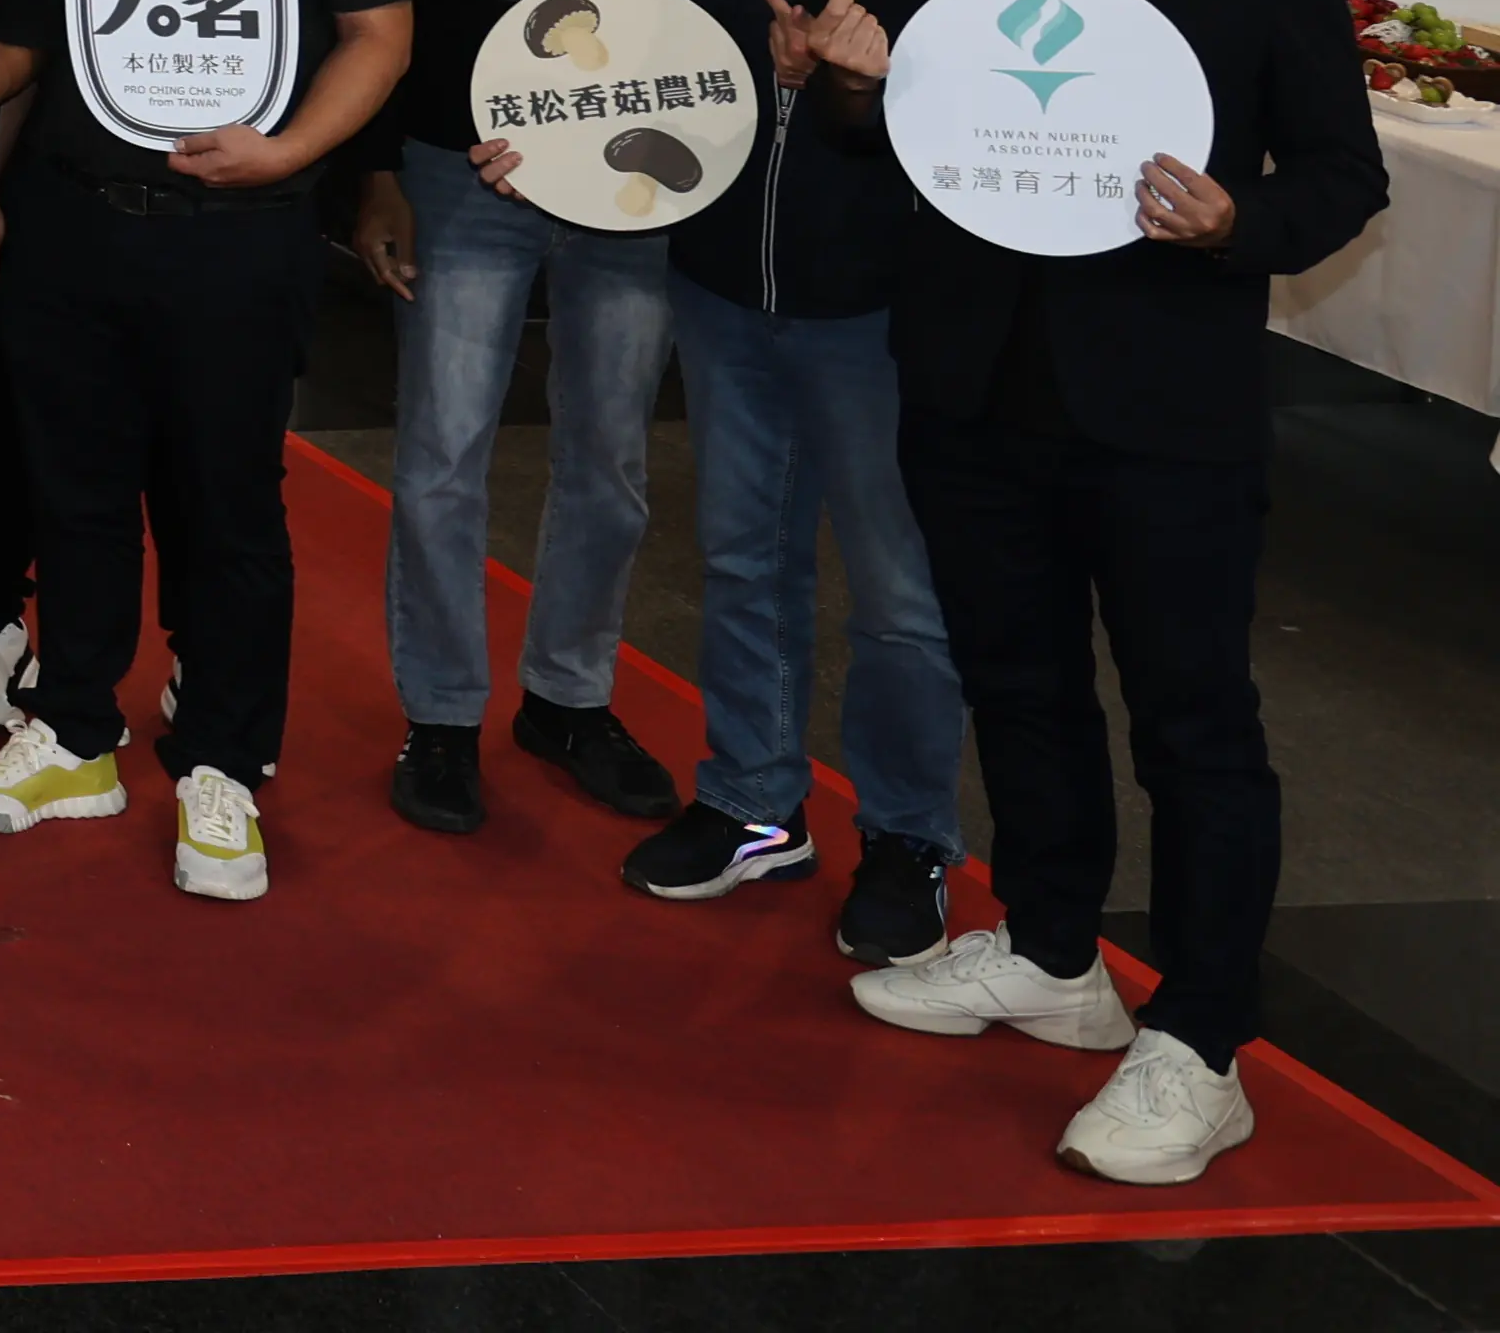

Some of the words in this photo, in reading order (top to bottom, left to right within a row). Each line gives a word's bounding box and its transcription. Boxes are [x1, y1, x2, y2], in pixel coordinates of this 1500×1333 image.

[122, 53, 245, 76] 本位製茶堂
[123, 85, 146, 94] PRO
[149, 85, 186, 96] CHING
[188, 86, 212, 96] CHA
[215, 87, 246, 97] SHOP
[148, 97, 174, 106] from
[177, 98, 221, 108] TAIWAN
[485, 70, 739, 132] 茂松香菇農場
[973, 127, 1039, 141] TAIWAN
[1048, 132, 1120, 145] NURTURE
[987, 144, 1108, 159] ASSOCIATION
[931, 165, 1125, 200] 臺灣育才協
